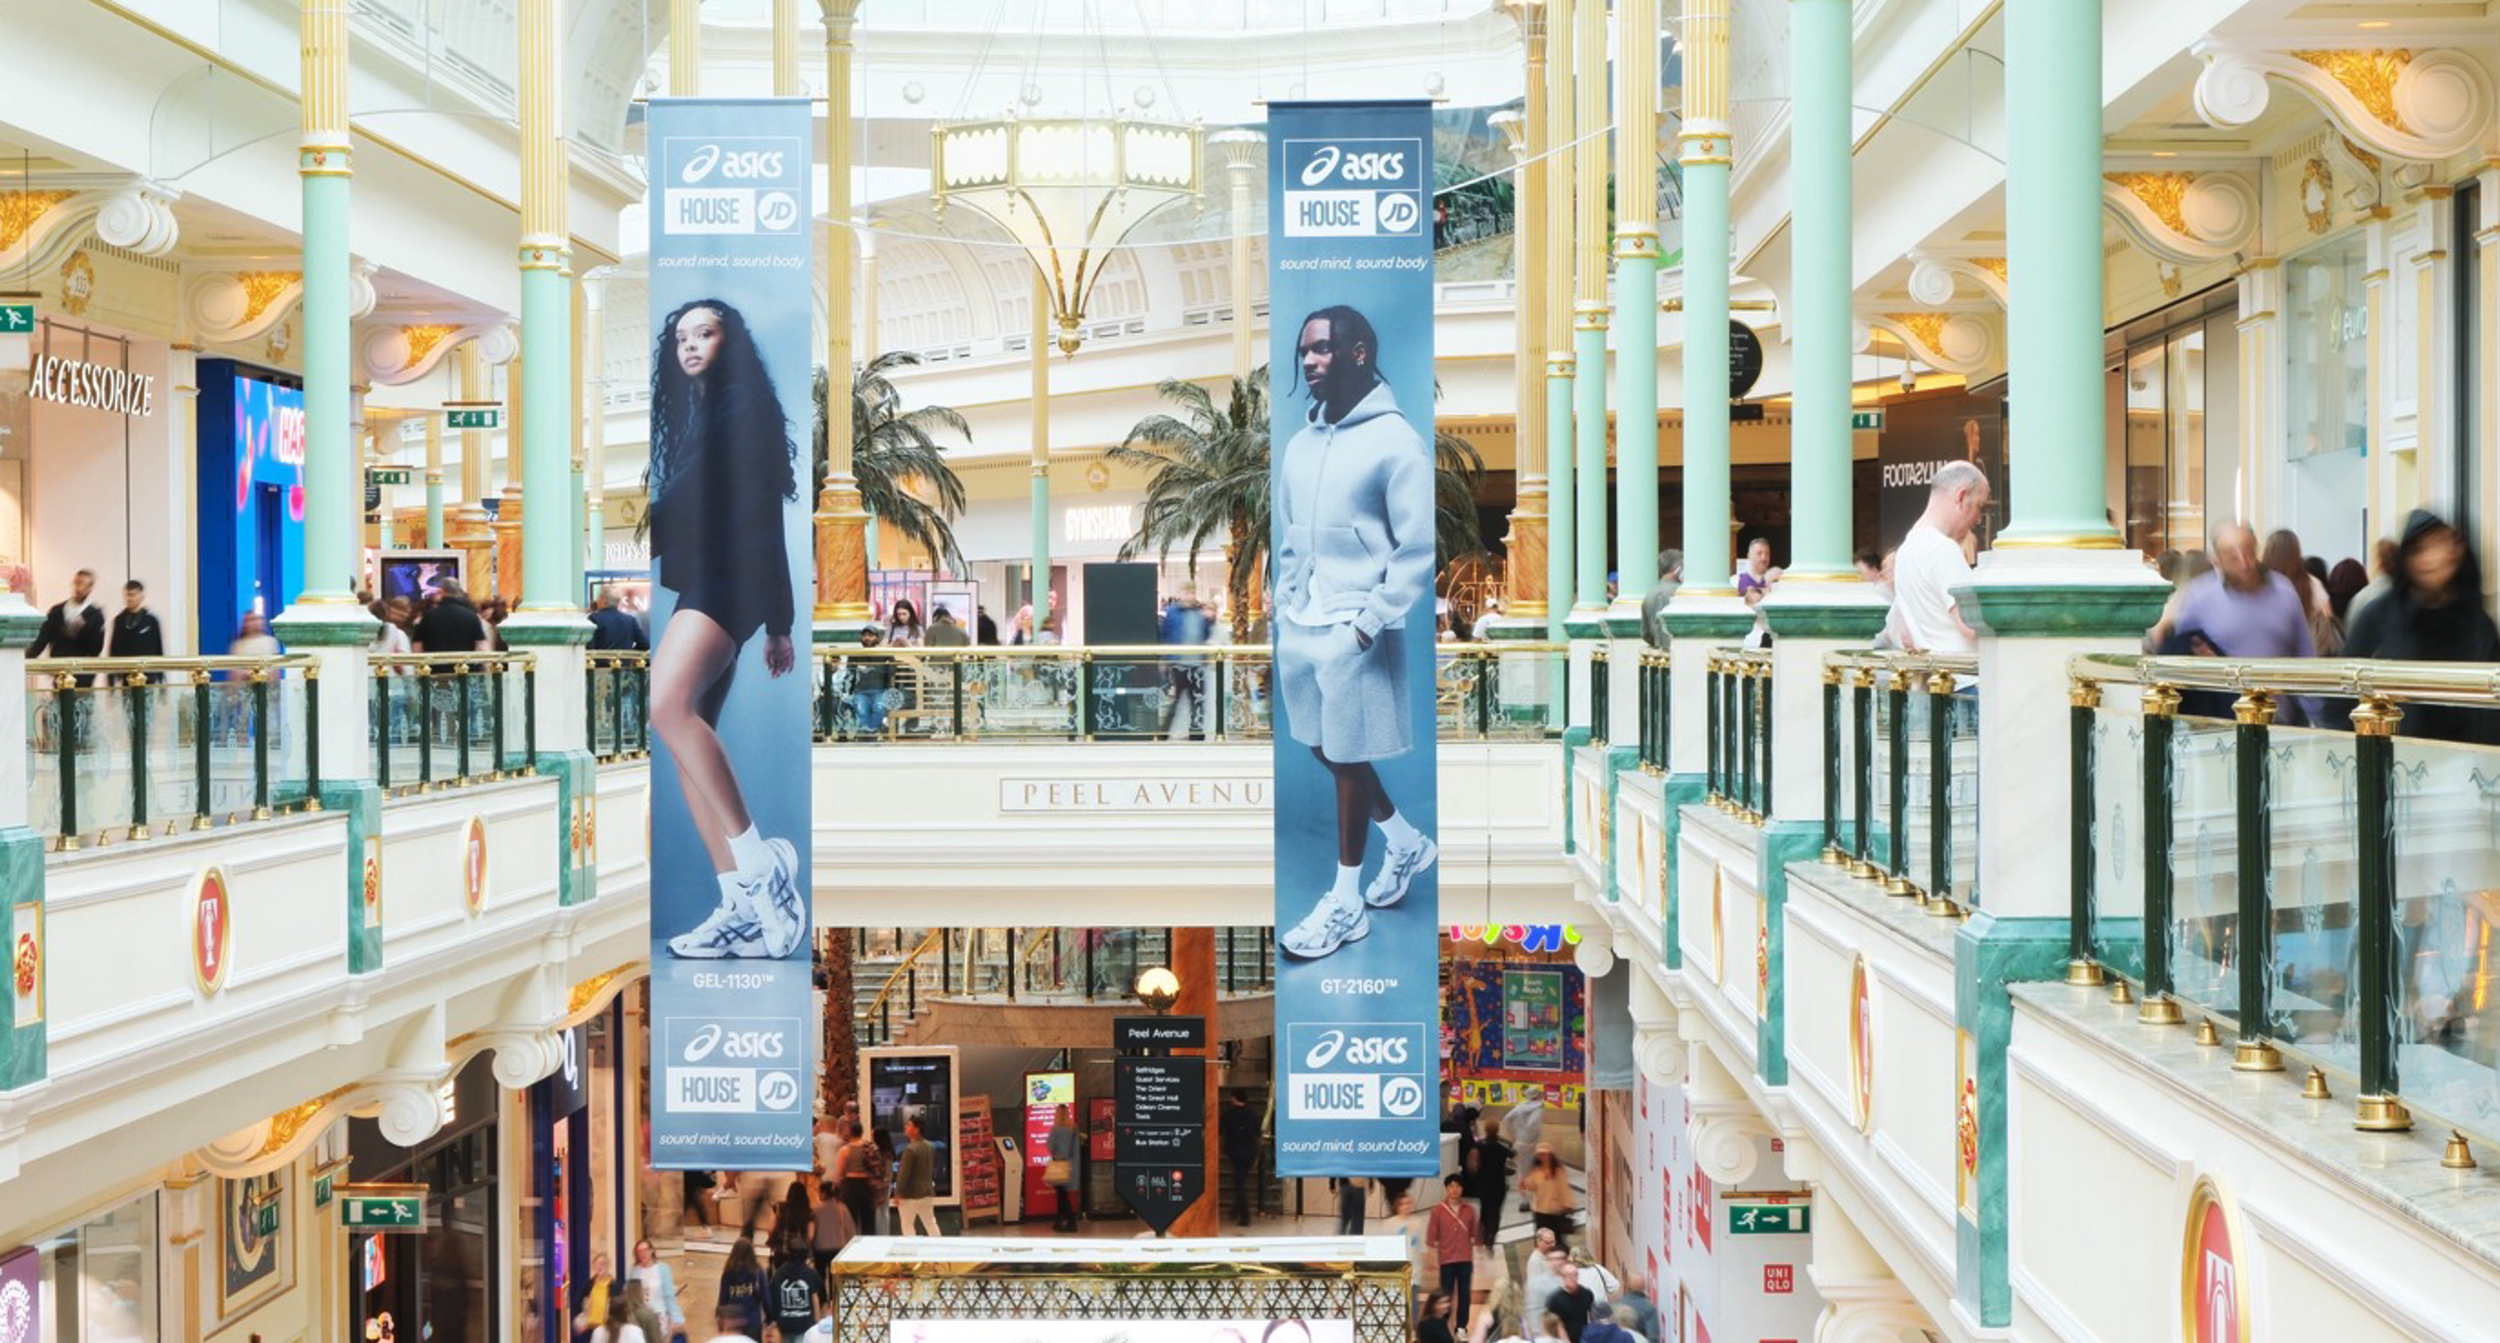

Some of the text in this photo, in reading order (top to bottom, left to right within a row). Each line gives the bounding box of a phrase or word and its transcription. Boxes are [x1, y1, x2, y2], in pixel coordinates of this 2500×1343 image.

[680, 198, 792, 225] HOUSE JD
[1300, 199, 1413, 227] HOUSE JD
[657, 254, 805, 270] sound mind, sound body
[1279, 256, 1428, 271] sound mind, sound body
[29, 353, 154, 417] ACCESSORIZE
[1065, 504, 1133, 541] GYMSHARK
[1024, 783, 1263, 804] PEEL AVENU
[1128, 1028, 1190, 1038] Peel Avenue
[682, 1076, 793, 1103] HOUSE JD
[1304, 1083, 1417, 1110] HOUSE JD
[659, 1132, 805, 1148] sound mind, sound body
[1282, 1139, 1430, 1154] sound mind, sound body
[1766, 1267, 1789, 1278] UNI
[1766, 1280, 1790, 1290] QLO
